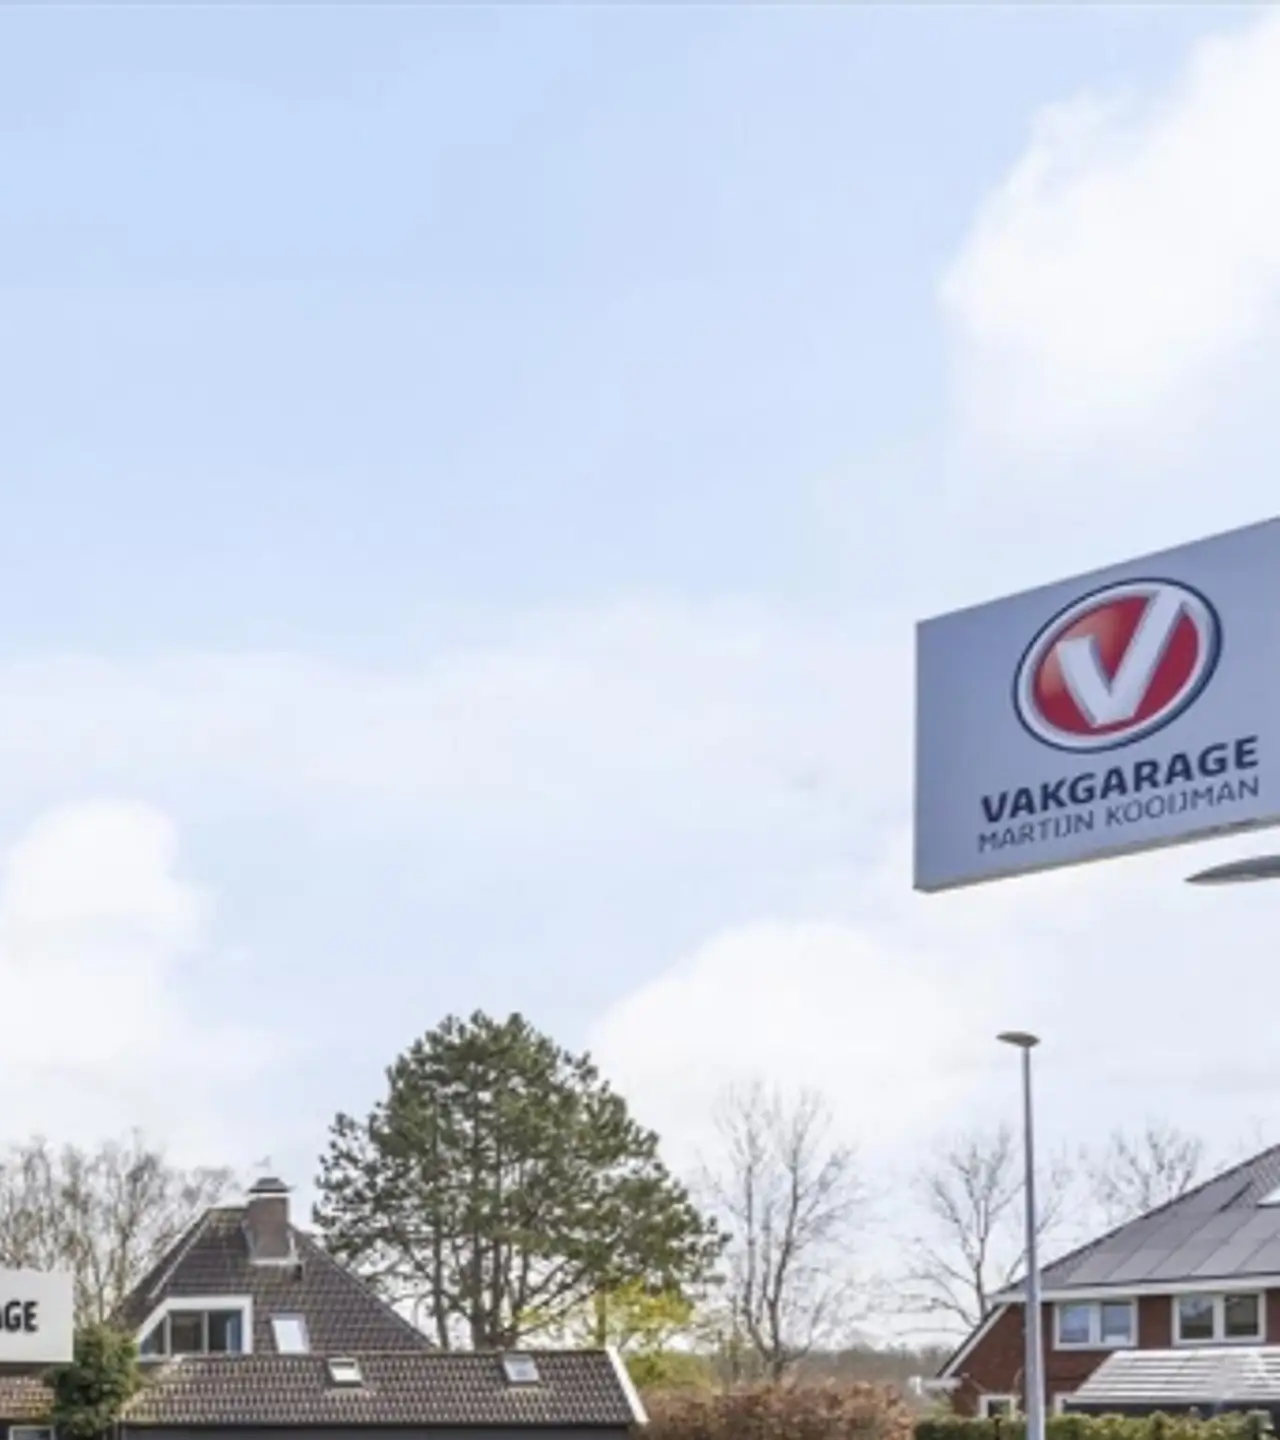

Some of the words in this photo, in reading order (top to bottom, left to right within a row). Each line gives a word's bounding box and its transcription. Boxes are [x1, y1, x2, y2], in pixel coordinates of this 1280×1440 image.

[977, 810, 1094, 853] MARTIJN
[1104, 775, 1260, 827] KOOIJMAN
[980, 735, 1260, 824] VAKGARAGE
